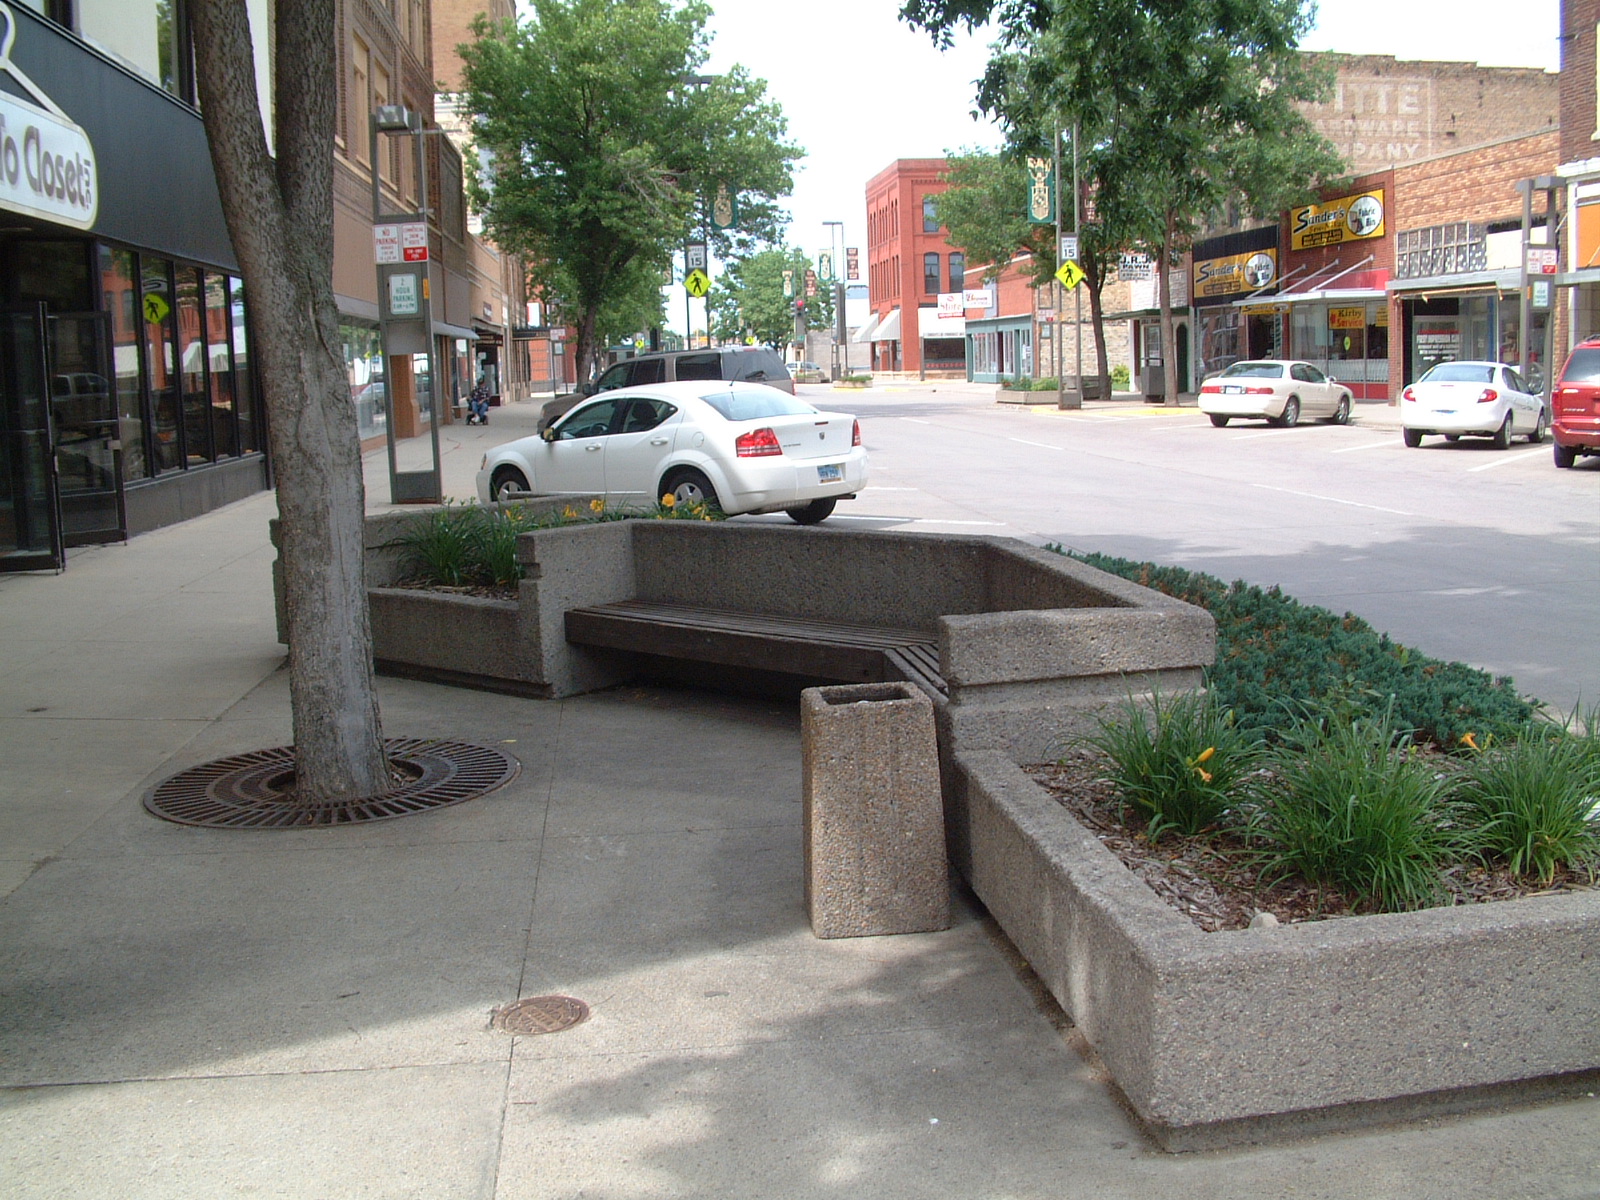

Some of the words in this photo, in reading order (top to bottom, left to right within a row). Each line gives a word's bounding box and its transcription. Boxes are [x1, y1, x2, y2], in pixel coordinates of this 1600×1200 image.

[1334, 83, 1420, 114] ITTE
[1316, 120, 1420, 137] ARDWARE
[1333, 143, 1420, 160] MPANY
[24, 126, 84, 207] Closet
[1358, 207, 1376, 218] Fabric
[1365, 217, 1376, 227] Bin
[1064, 249, 1075, 257] 15
[691, 257, 702, 266] 15
[396, 286, 410, 294] HOUR
[393, 294, 414, 302] PARKING
[1338, 308, 1363, 318] Kirby
[1337, 318, 1364, 327] Service
